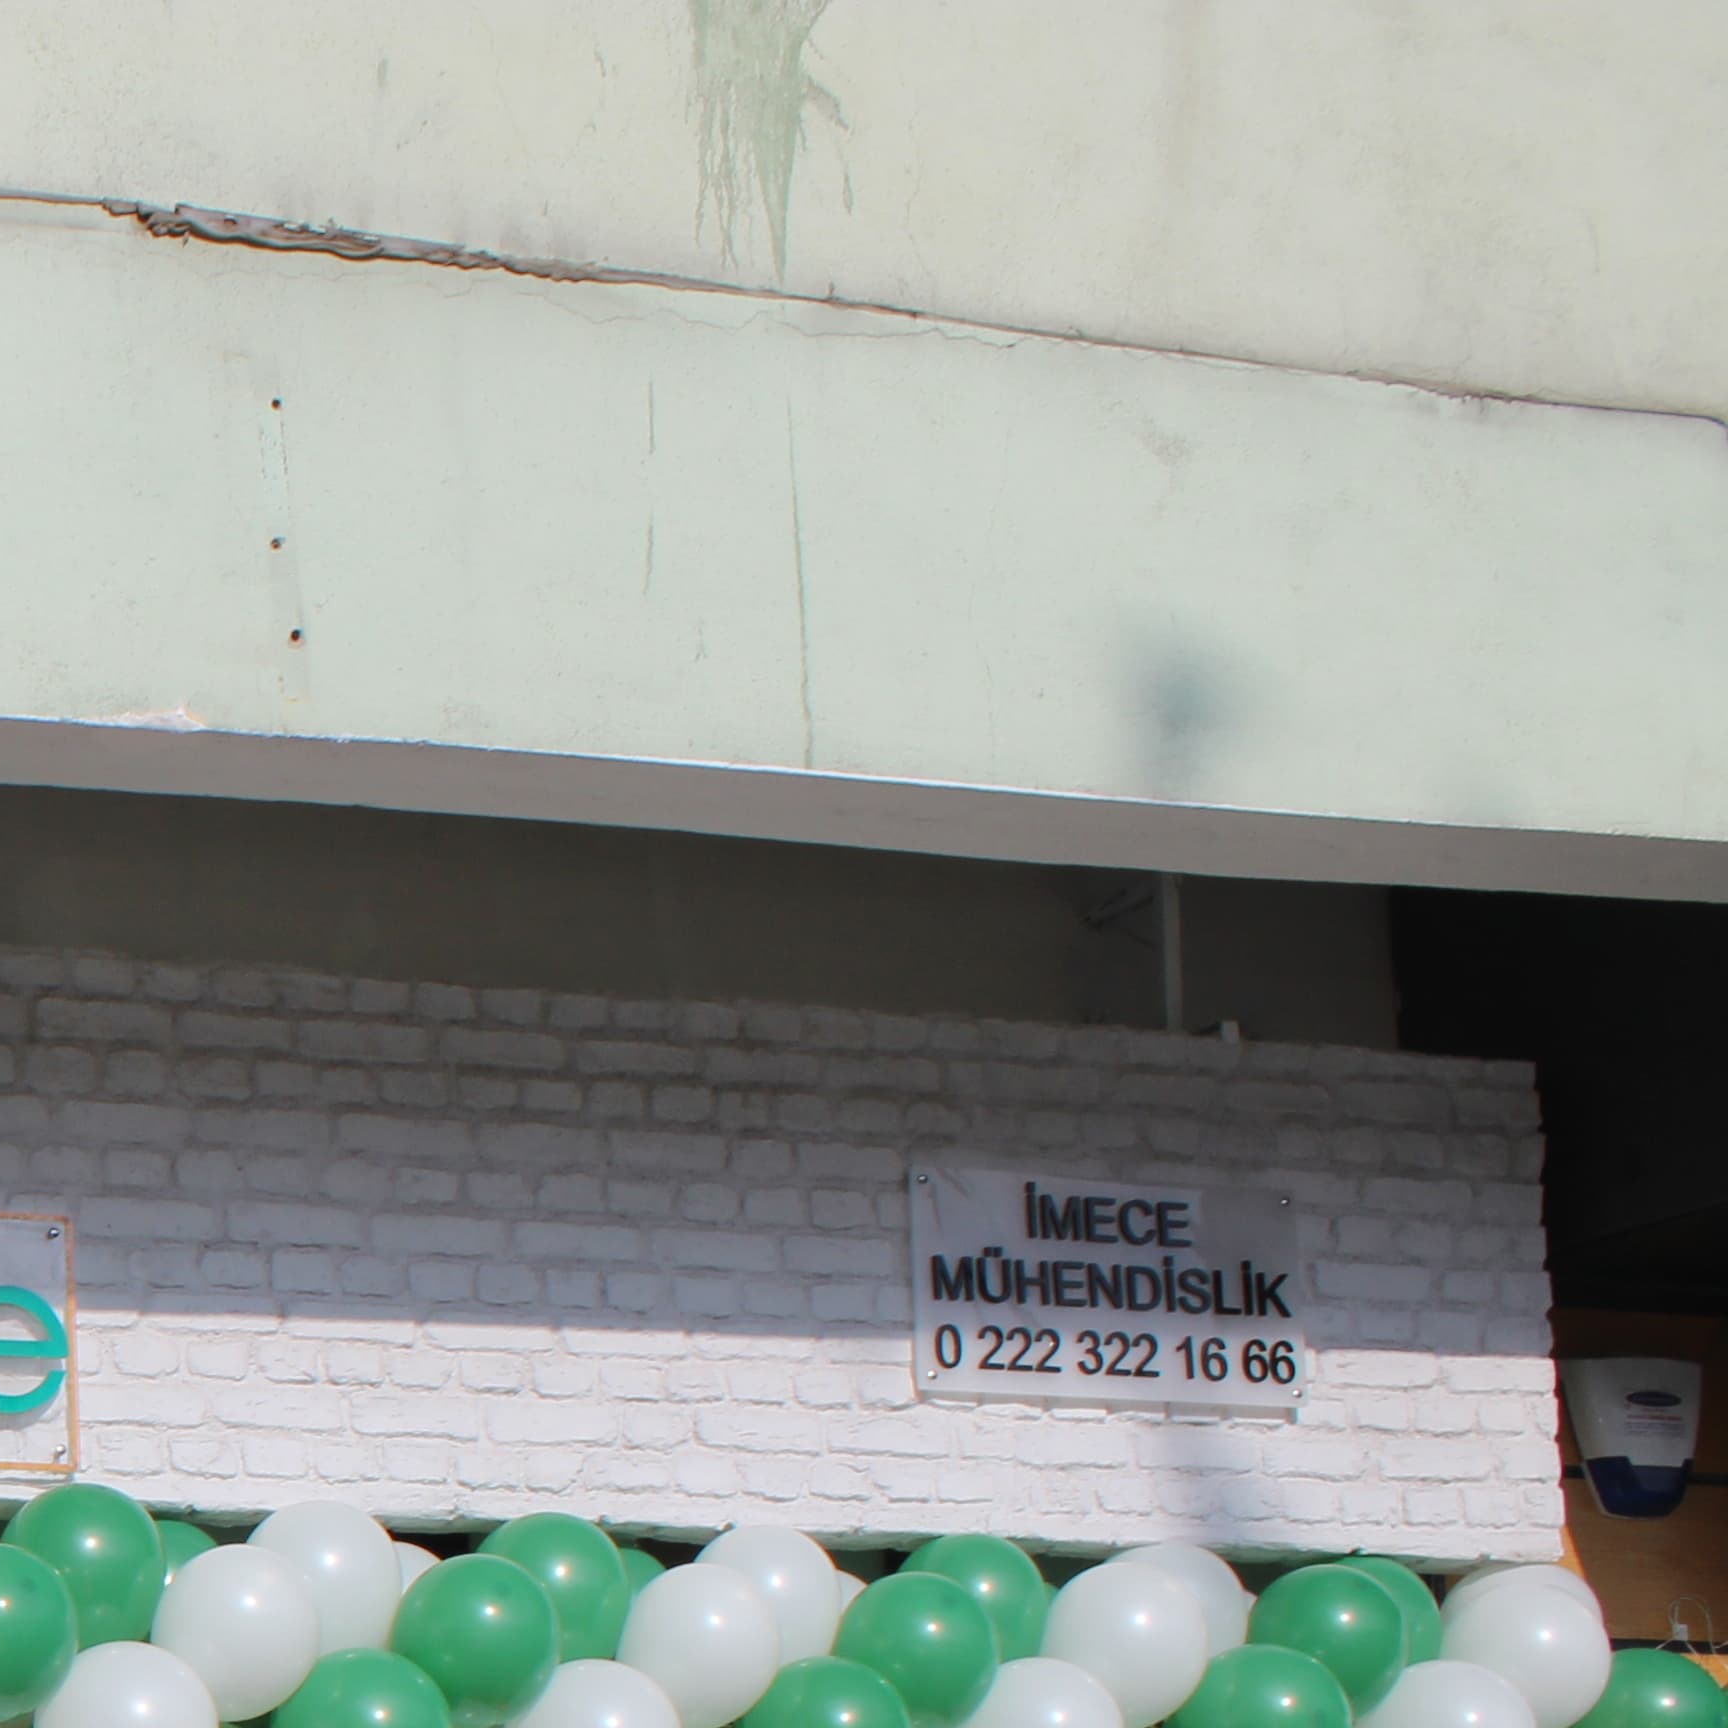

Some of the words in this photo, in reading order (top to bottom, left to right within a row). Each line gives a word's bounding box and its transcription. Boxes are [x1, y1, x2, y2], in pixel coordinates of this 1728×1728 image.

[1025, 1181, 1193, 1248] İMECE
[930, 1246, 1292, 1319] MÜHENDİSLİK
[934, 1324, 963, 1369] 0
[977, 1325, 1062, 1373] 222
[1075, 1329, 1160, 1378] 322
[1175, 1335, 1229, 1382] 16
[1242, 1338, 1297, 1384] 66
